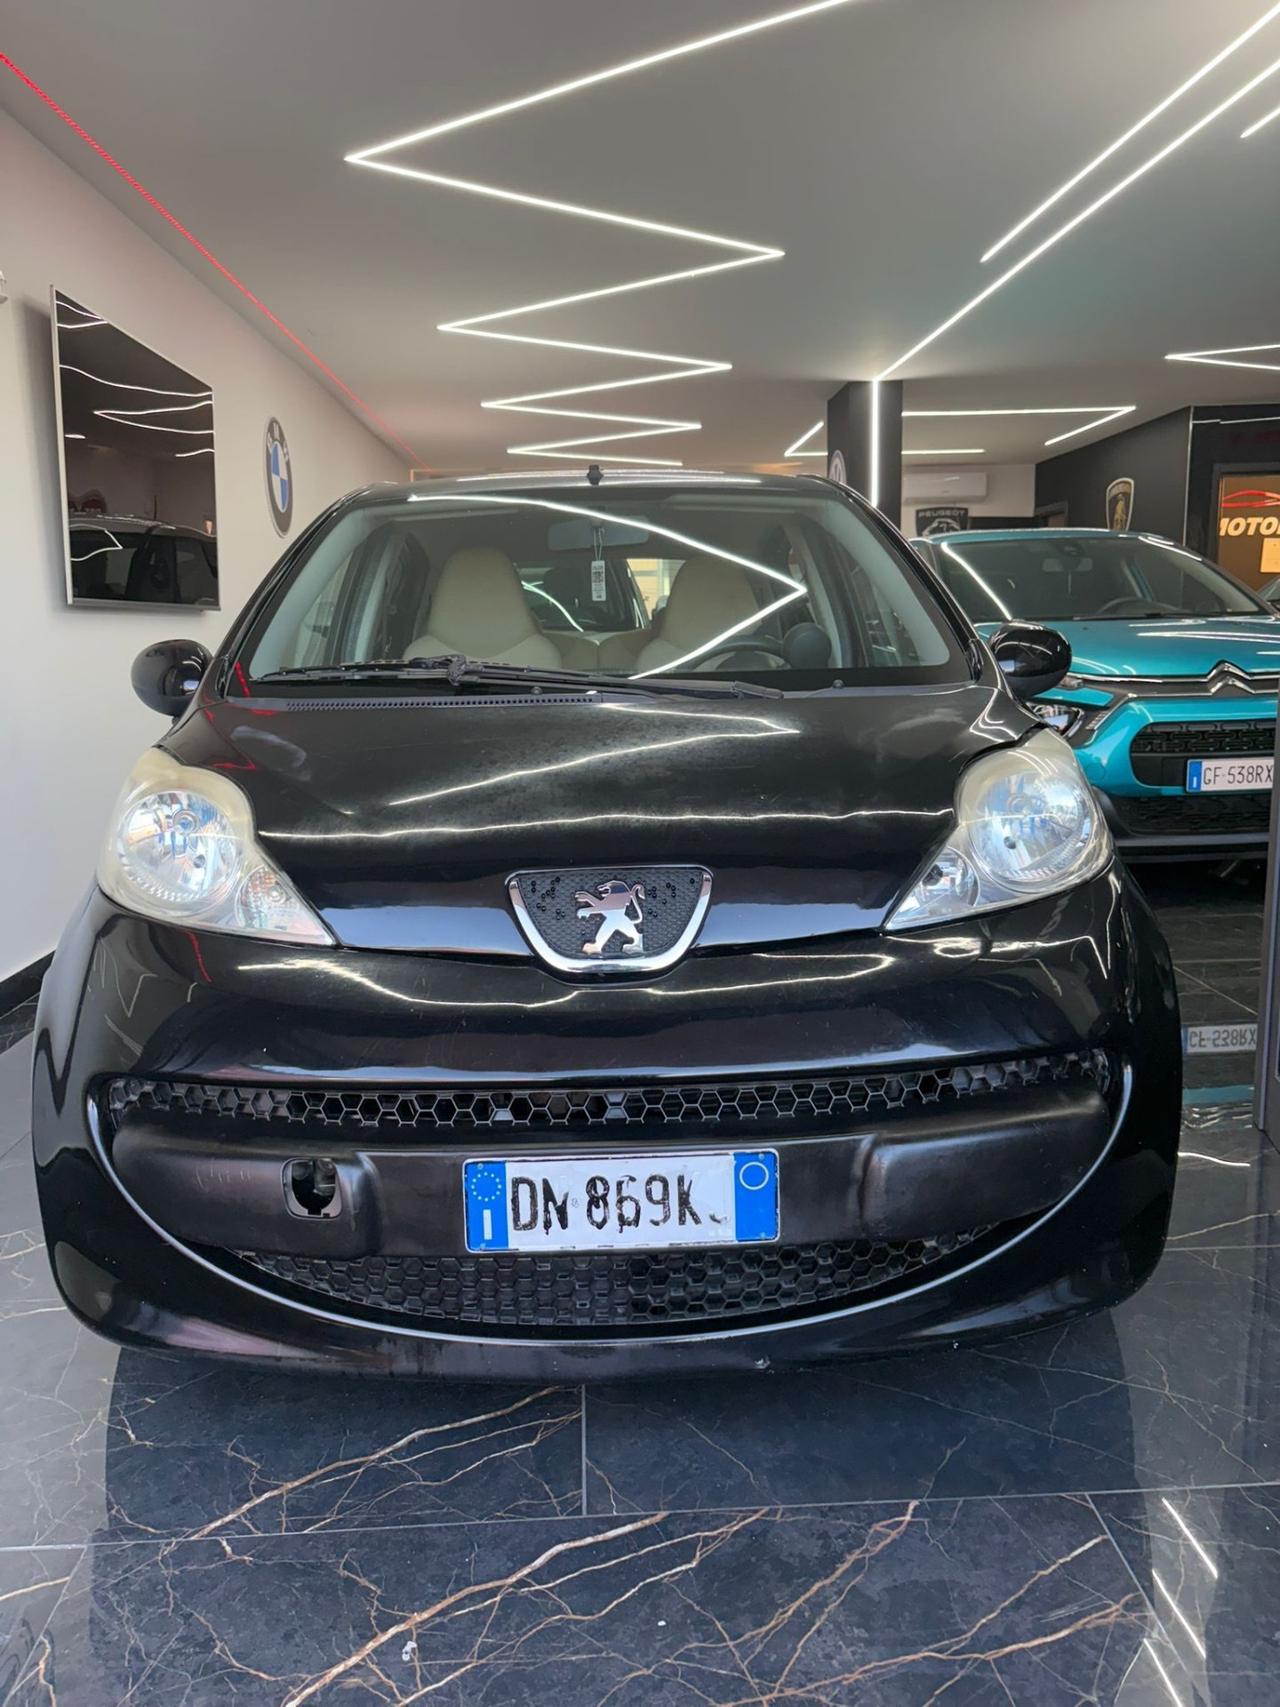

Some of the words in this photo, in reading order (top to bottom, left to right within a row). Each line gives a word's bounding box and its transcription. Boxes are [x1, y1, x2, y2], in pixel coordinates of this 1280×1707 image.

[918, 509, 965, 518] PEUGEOT
[1203, 767, 1222, 785] GF
[1227, 765, 1273, 785] 538RX
[511, 1176, 569, 1232] DN
[586, 1174, 728, 1232] 869K
